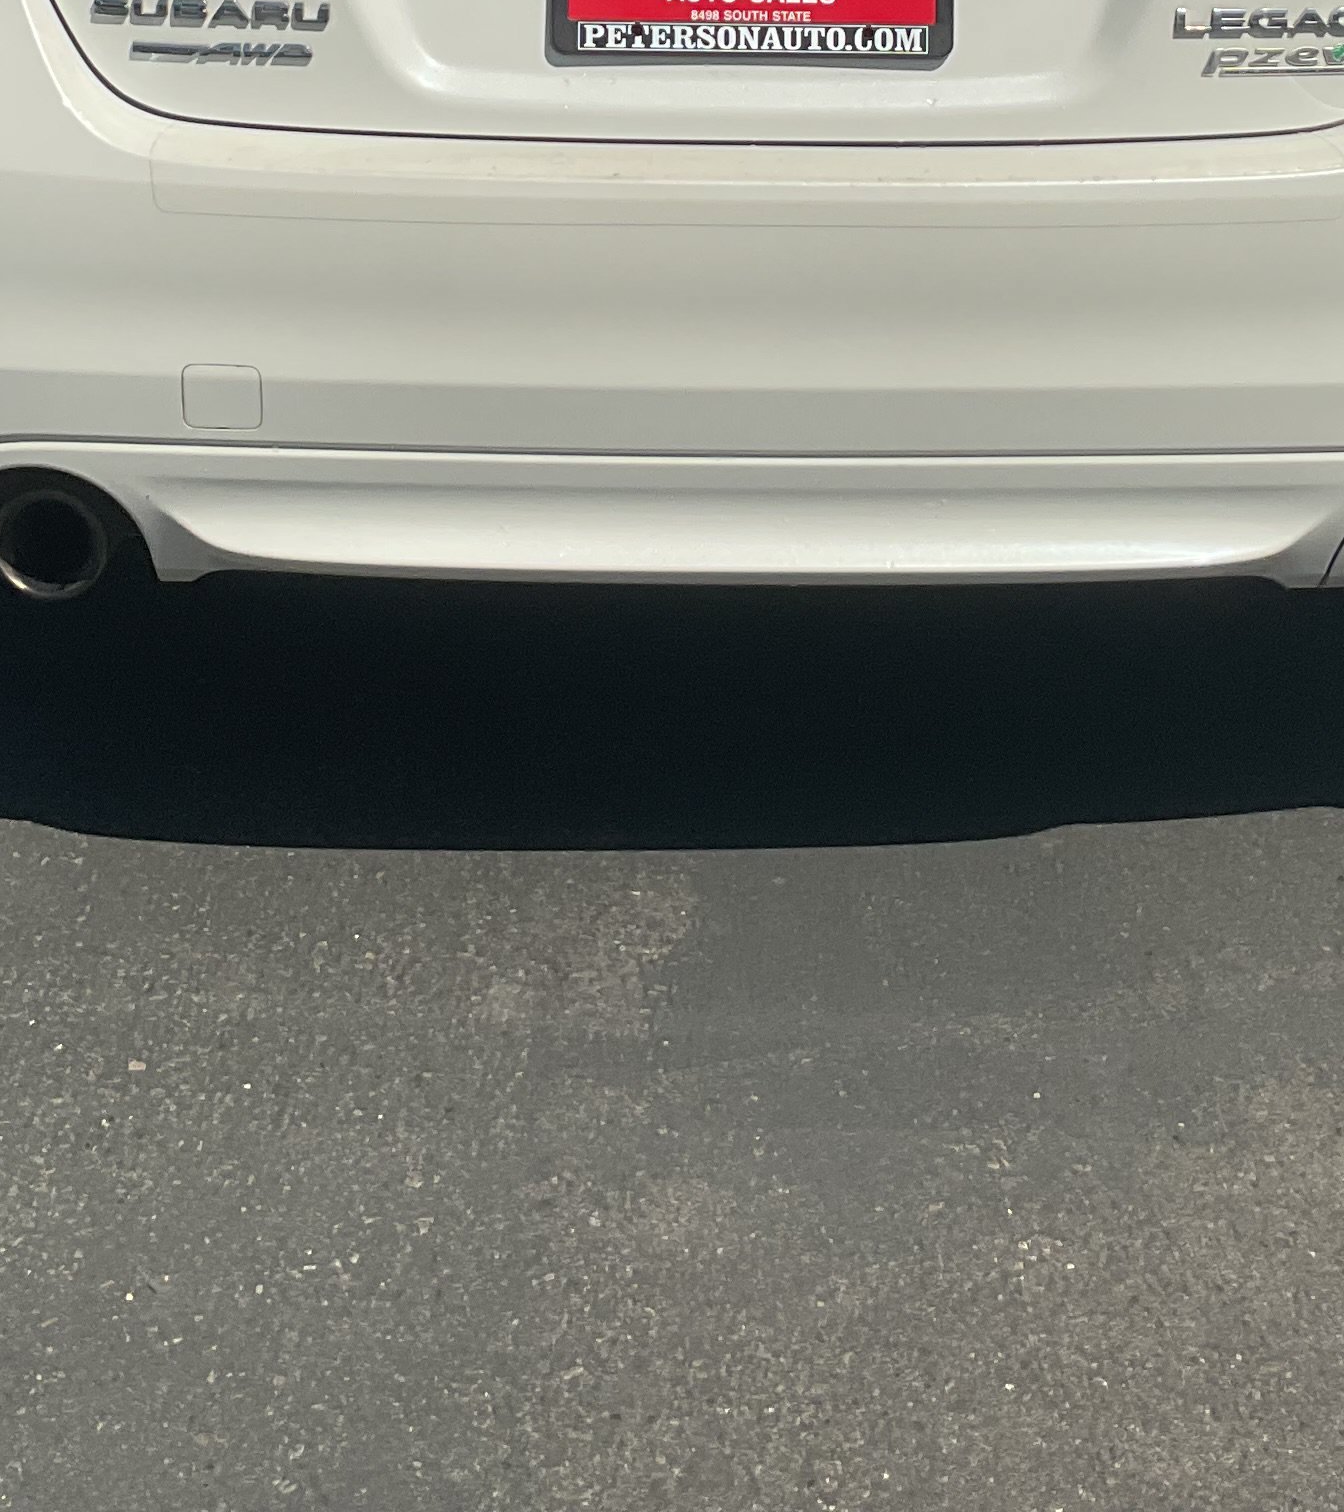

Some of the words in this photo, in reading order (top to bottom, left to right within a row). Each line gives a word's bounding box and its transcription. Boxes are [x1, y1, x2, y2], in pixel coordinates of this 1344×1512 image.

[690, 10, 720, 21] 8498
[723, 10, 768, 22] SOUTH
[772, 11, 811, 22] STATE
[583, 24, 923, 52] PETERSONAUTO.COM
